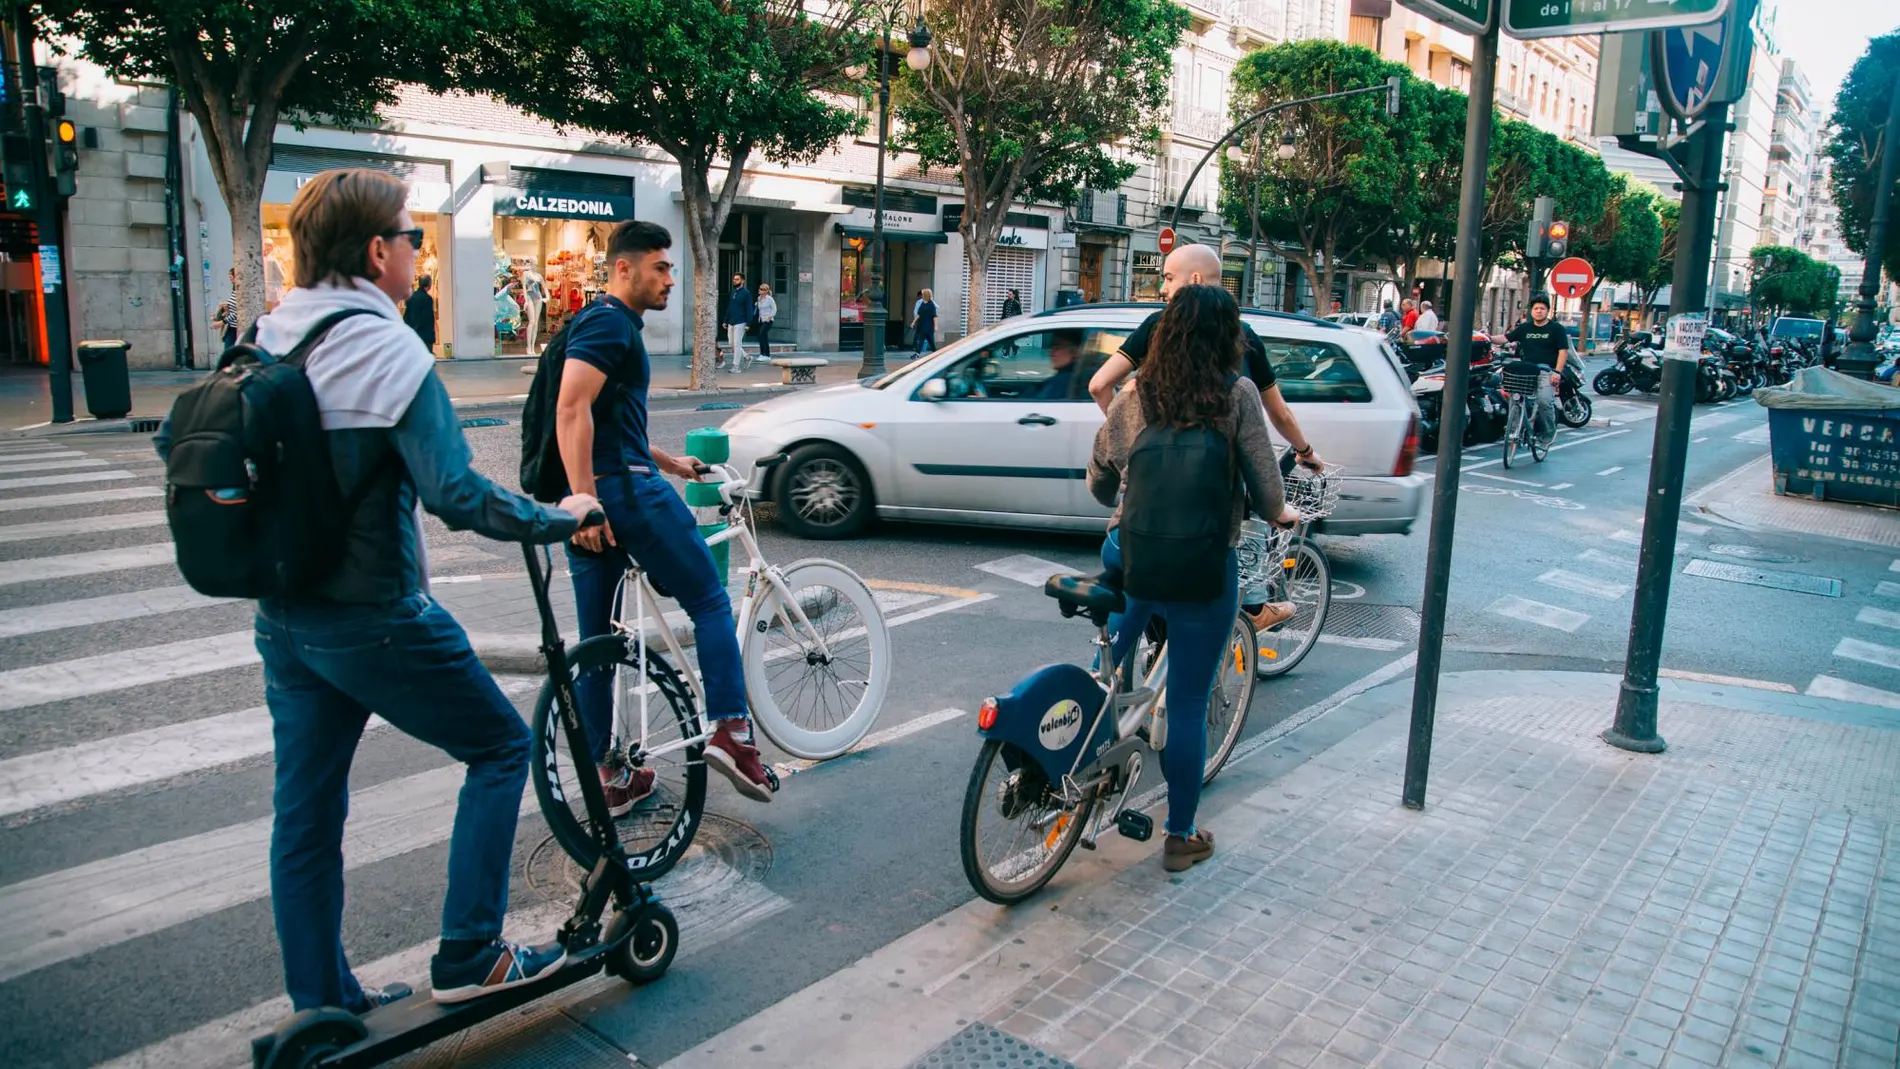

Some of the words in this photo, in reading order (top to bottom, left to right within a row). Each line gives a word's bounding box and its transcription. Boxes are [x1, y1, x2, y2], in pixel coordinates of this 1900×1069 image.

[1540, 3, 1559, 16] de
[516, 196, 614, 216] CALZEDONIA
[882, 212, 913, 223] MALONE
